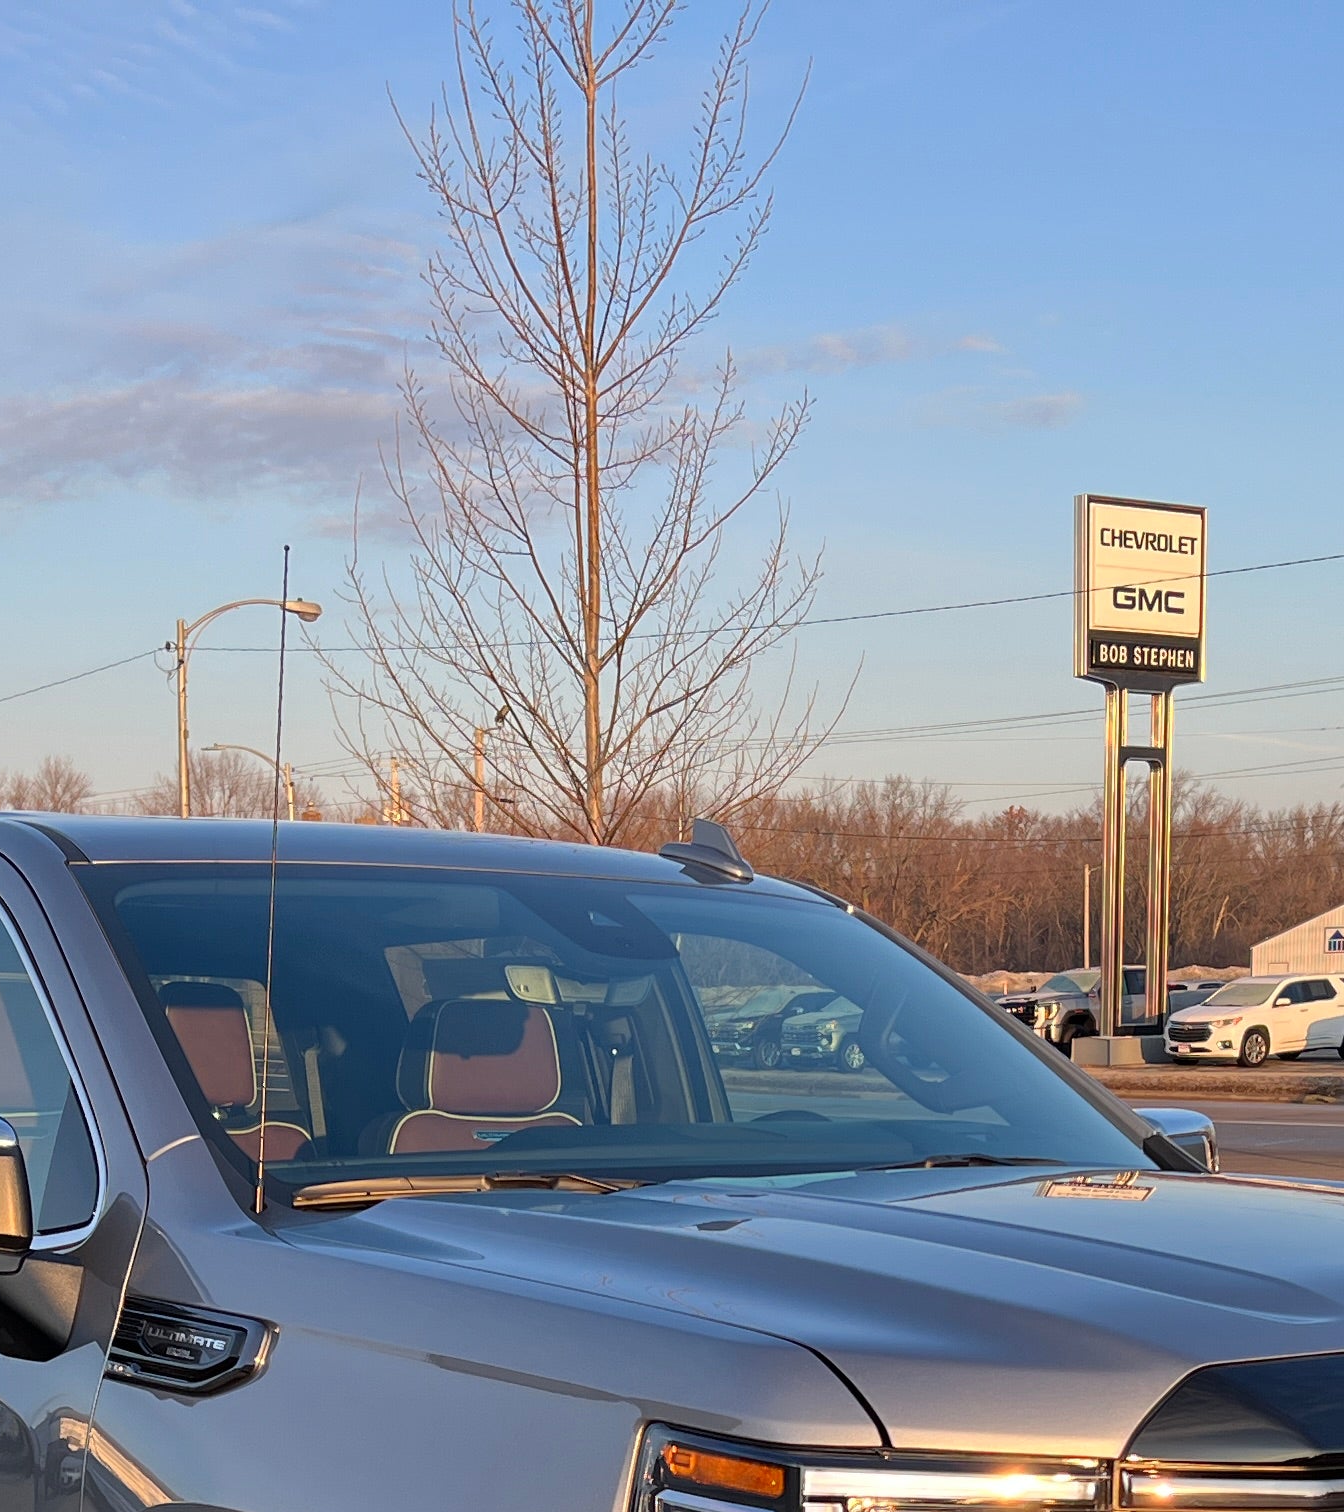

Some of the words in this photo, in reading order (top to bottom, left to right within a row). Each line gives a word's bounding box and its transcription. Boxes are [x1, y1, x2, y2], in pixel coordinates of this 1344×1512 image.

[1100, 528, 1197, 555] CHEVROLET
[1113, 586, 1185, 614] GMC
[1099, 644, 1128, 664] BOB
[1133, 646, 1195, 668] STEPHEN
[147, 1327, 226, 1351] ULTIMATE
